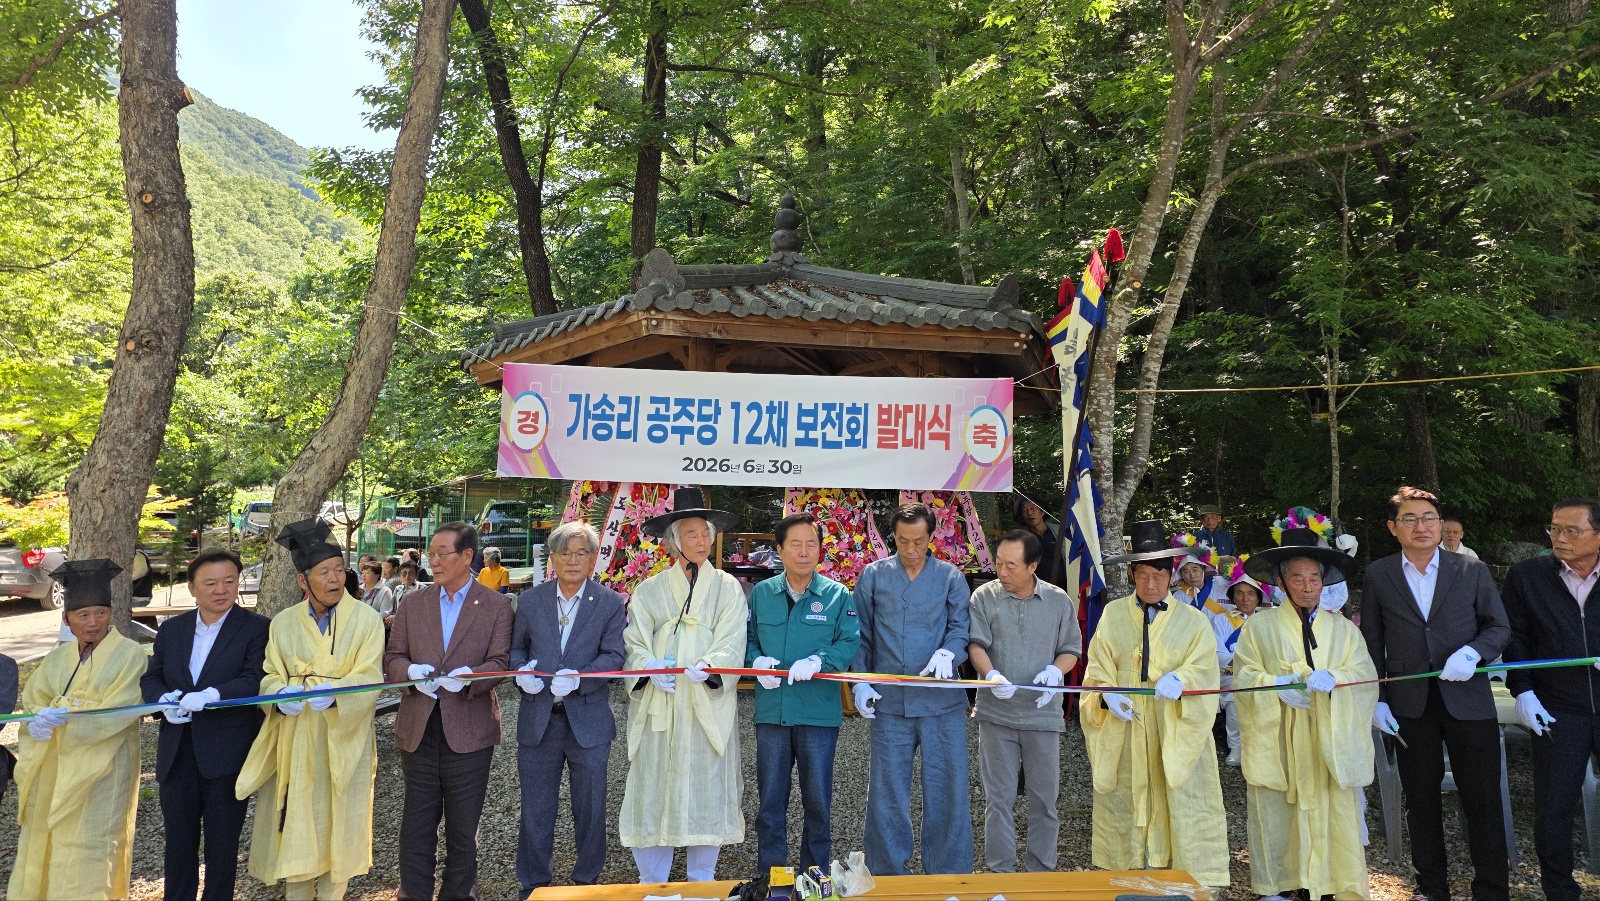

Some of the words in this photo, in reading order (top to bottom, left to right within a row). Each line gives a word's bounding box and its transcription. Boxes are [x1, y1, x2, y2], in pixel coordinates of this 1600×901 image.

[516, 410, 540, 435] 경
[566, 392, 641, 443] 가송리
[646, 395, 722, 446] 공주당
[730, 400, 789, 448] 12채
[794, 402, 869, 450] 보전회
[876, 403, 952, 451] 발대식
[972, 423, 998, 449] 축
[681, 456, 741, 474] 2026년
[743, 459, 765, 474] 6월
[767, 459, 803, 475] 30일
